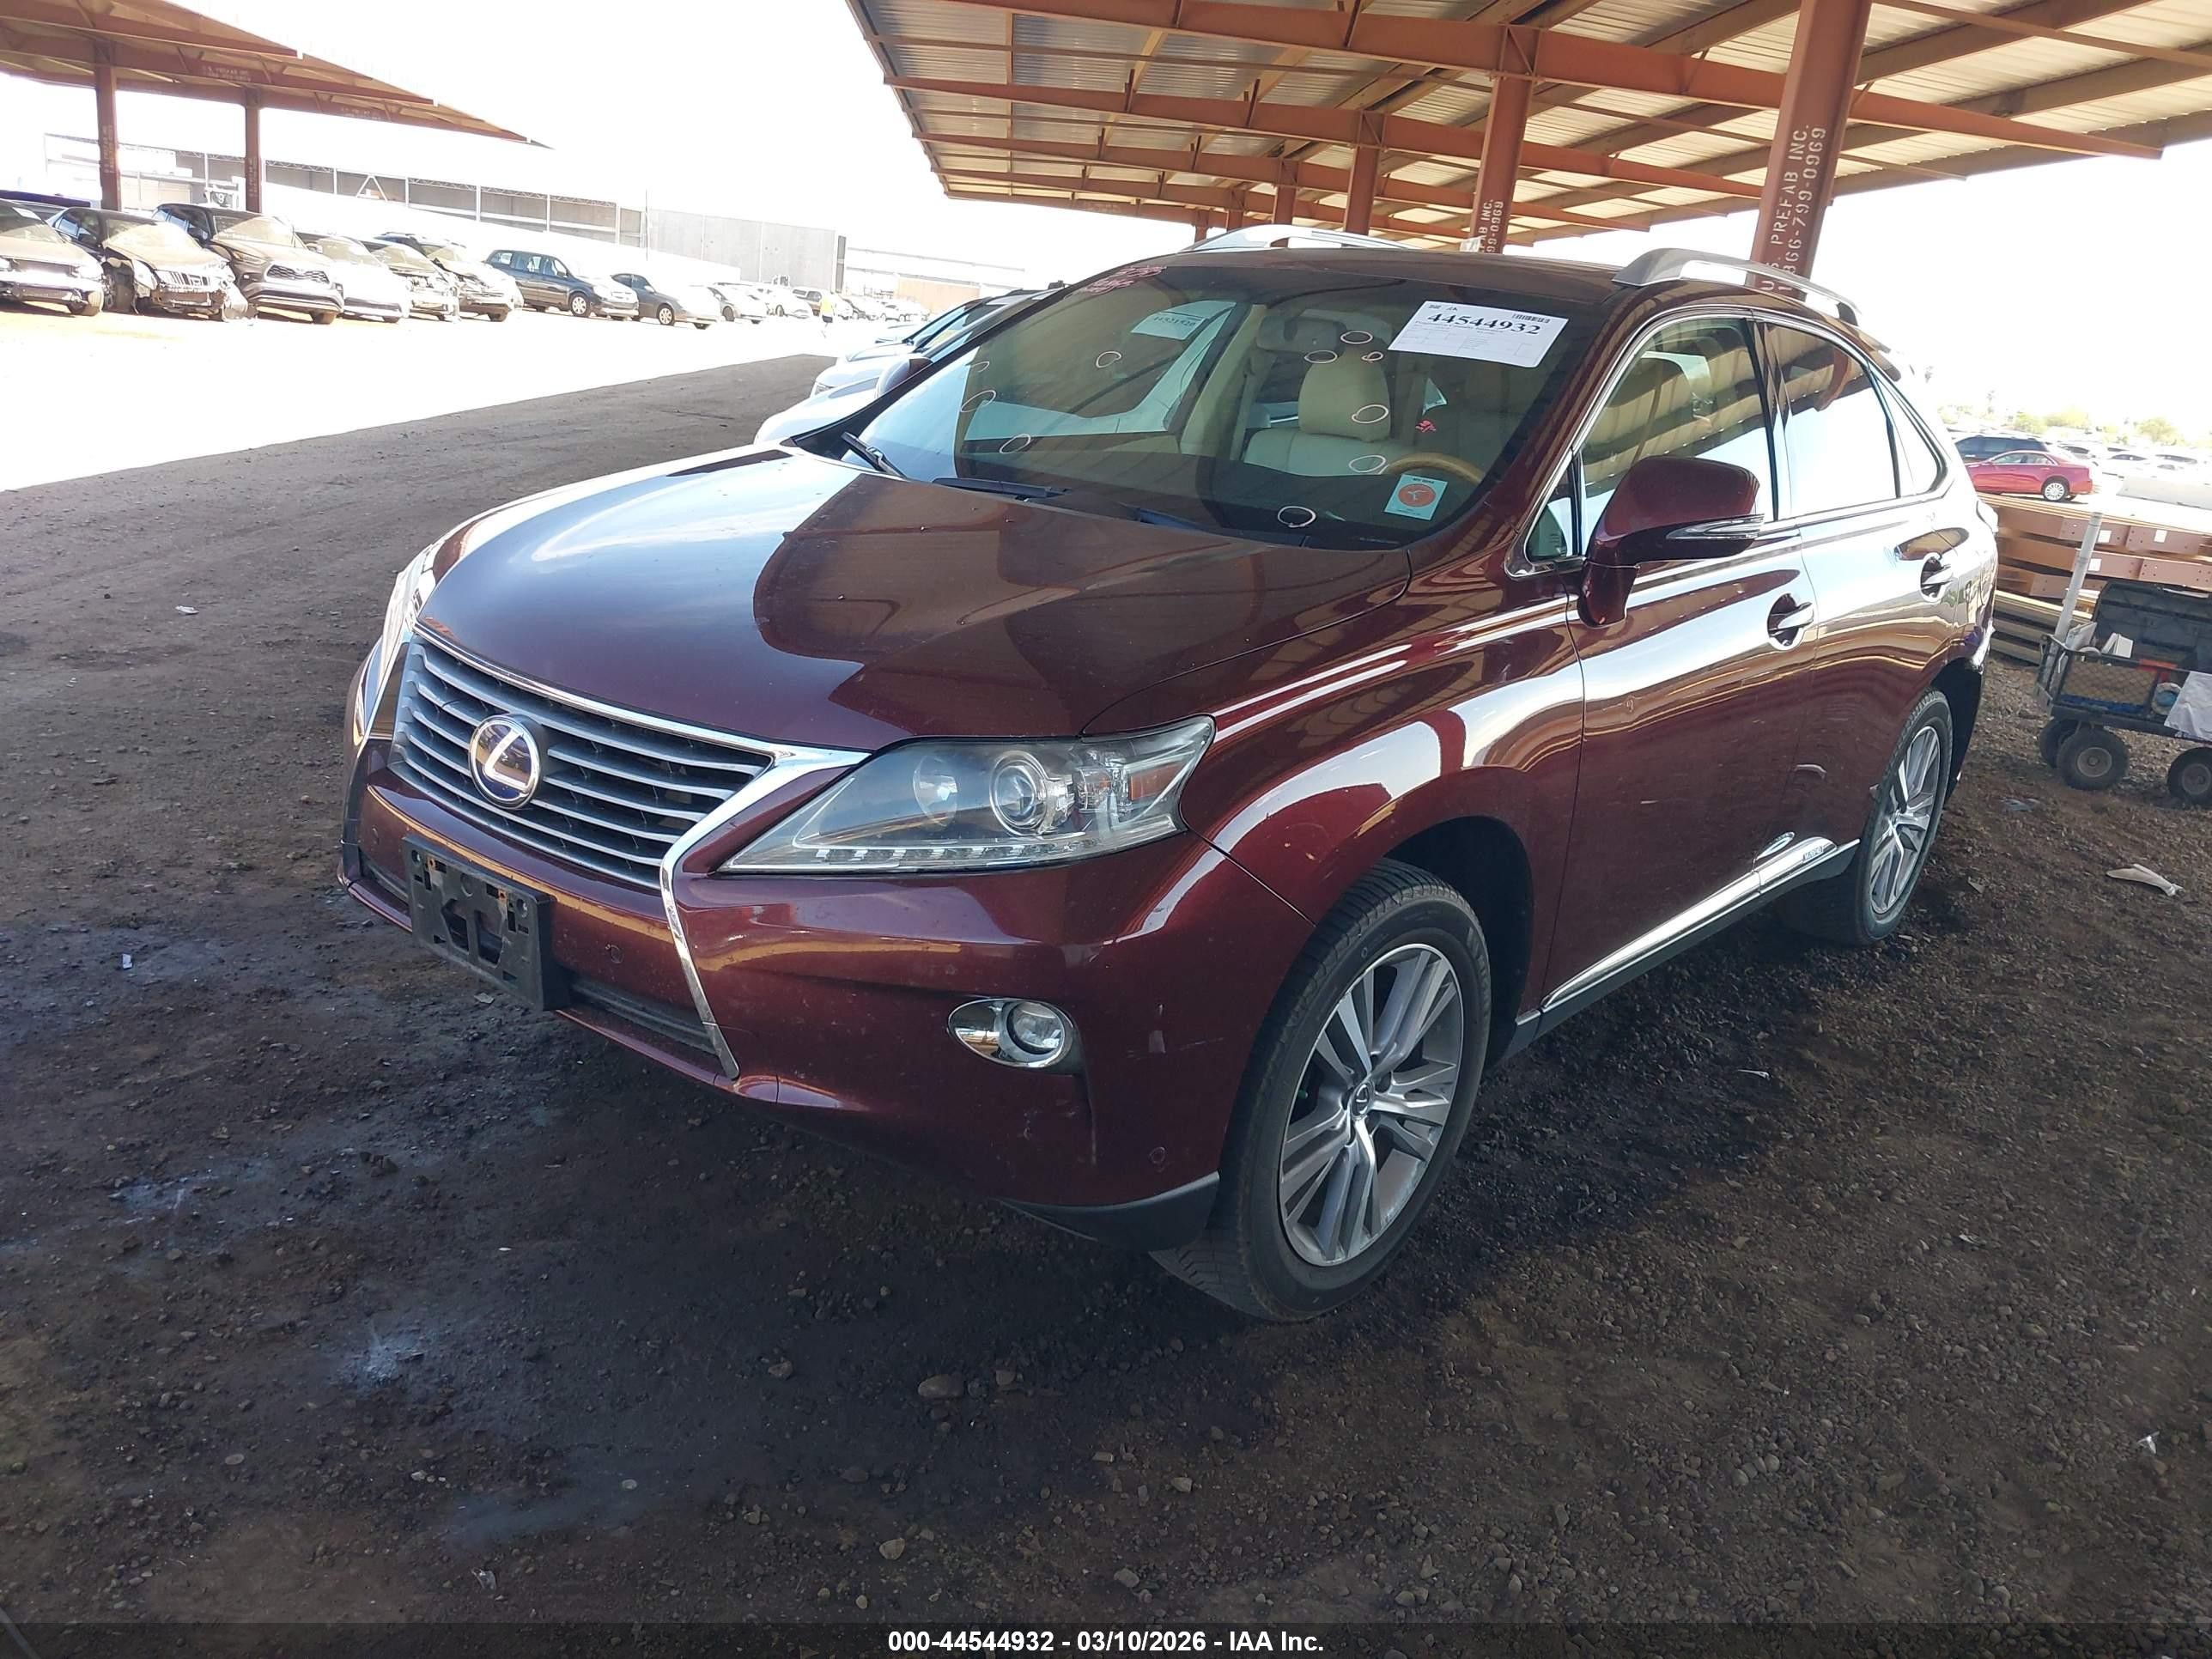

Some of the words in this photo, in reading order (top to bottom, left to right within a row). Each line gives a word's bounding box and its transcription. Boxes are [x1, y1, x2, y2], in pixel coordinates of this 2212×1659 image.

[1480, 199, 1494, 221] INC.
[1771, 171, 1799, 246] PREFAB
[1788, 125, 1809, 161] INC.
[1778, 127, 1826, 291] 1866-799-0969
[1427, 313, 1541, 335] 44544932
